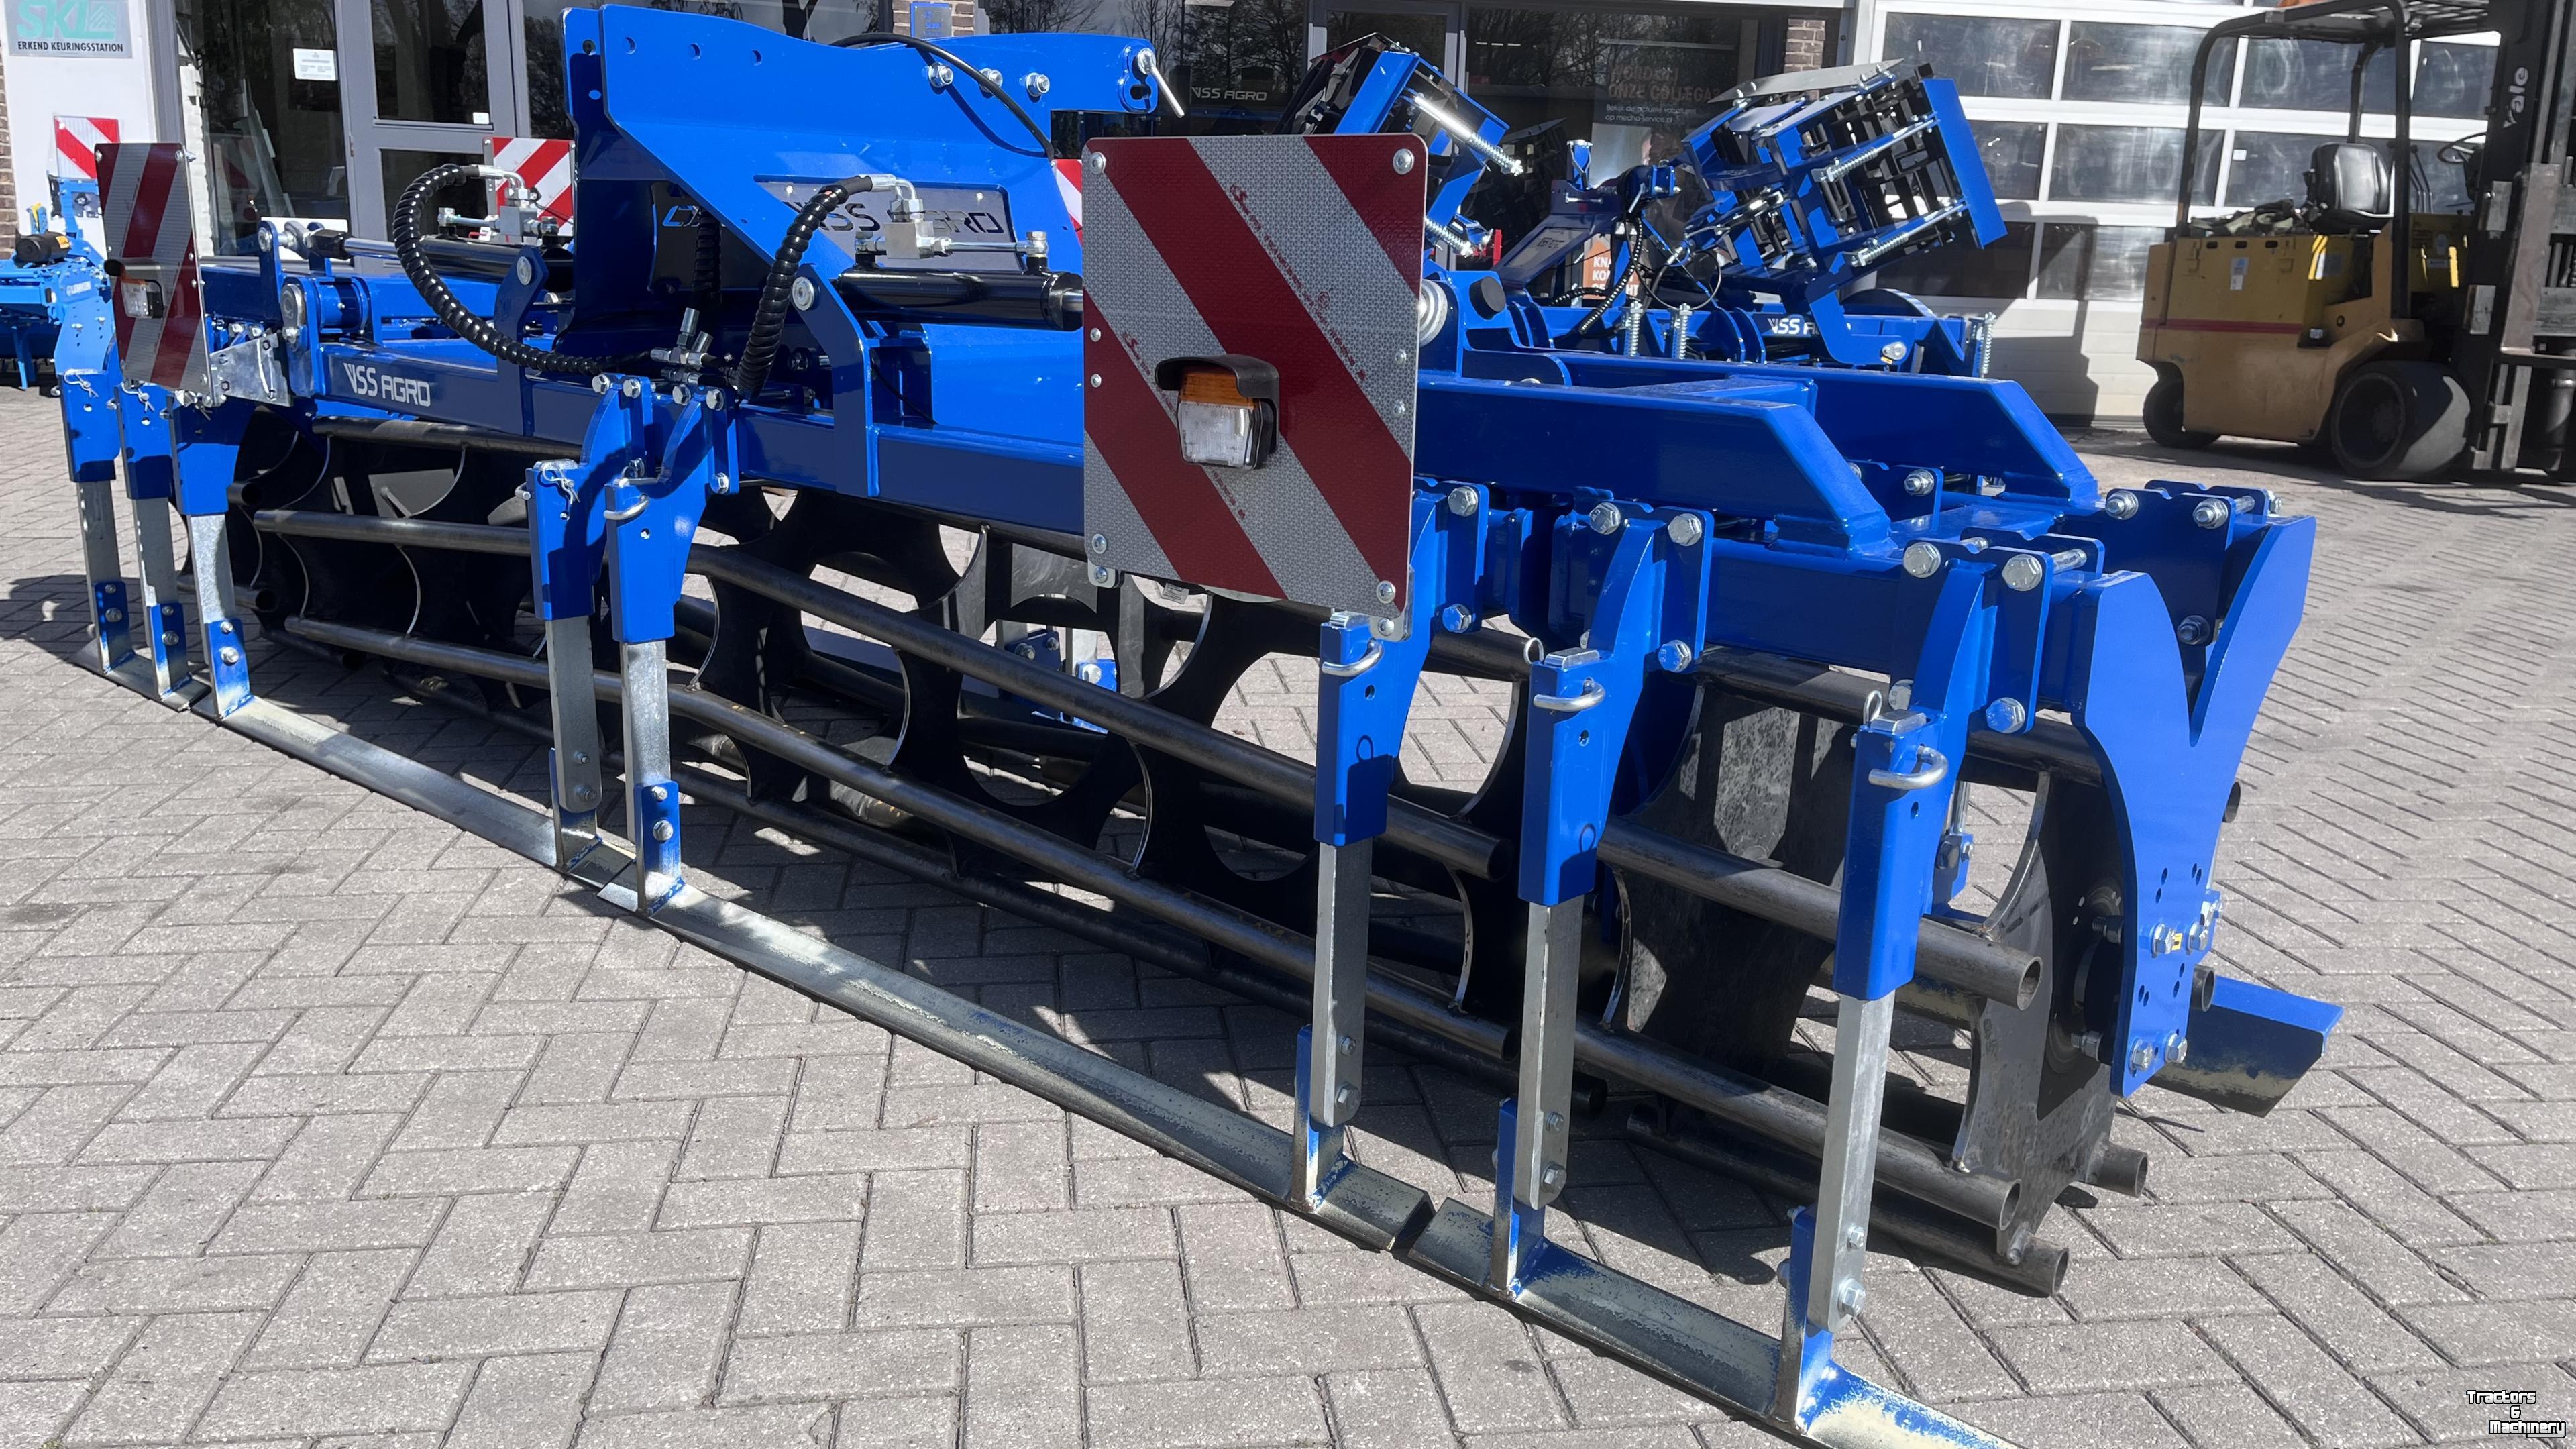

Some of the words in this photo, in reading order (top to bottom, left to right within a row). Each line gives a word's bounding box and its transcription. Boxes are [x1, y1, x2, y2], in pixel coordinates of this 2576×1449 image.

[17, 40, 49, 50] ERKEND
[50, 42, 123, 52] KEURINGSSTATION
[1191, 86, 1222, 99] VSS
[1224, 90, 1267, 101] AGRO
[2502, 66, 2529, 129] Yale
[1767, 317, 1800, 335] VSS
[343, 362, 378, 398] VSS
[380, 374, 431, 407] AGRO
